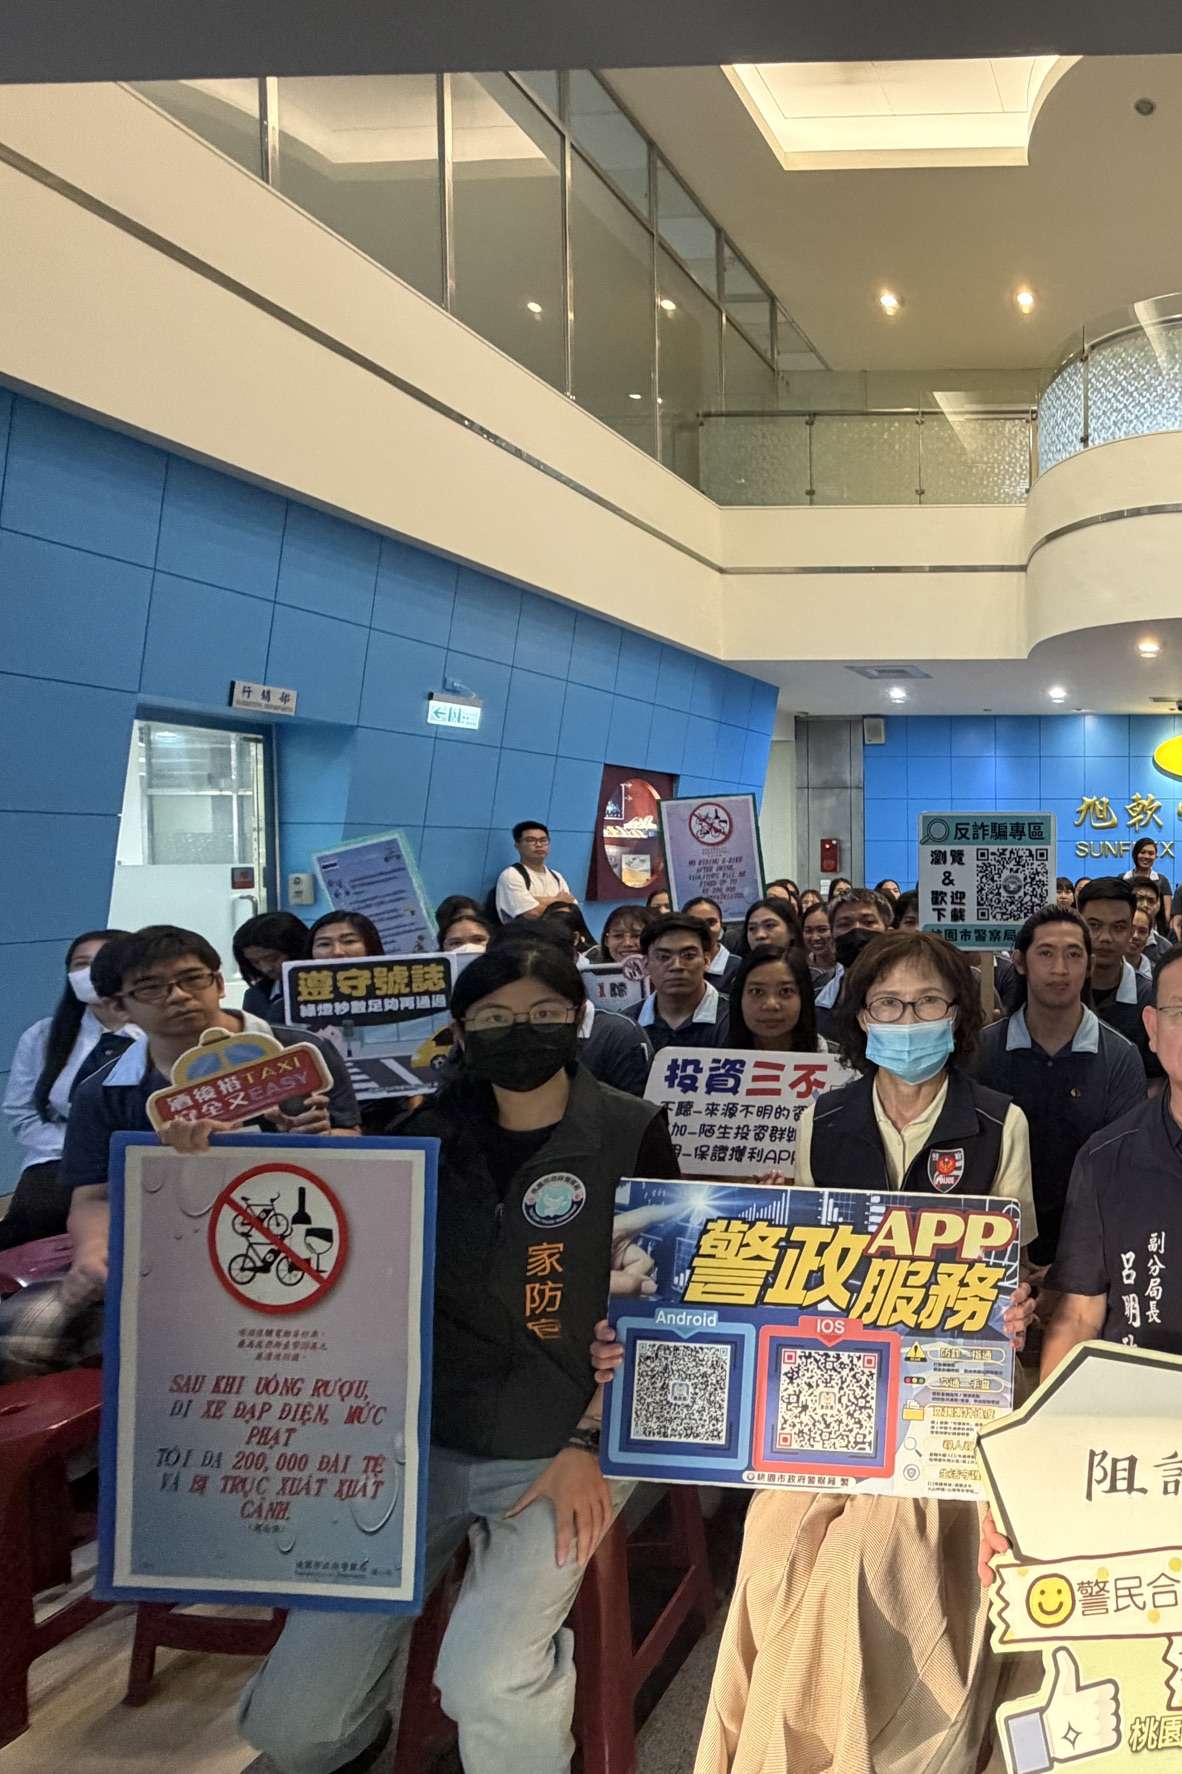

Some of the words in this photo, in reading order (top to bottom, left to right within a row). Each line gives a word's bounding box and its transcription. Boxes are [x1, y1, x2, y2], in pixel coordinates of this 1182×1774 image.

[954, 822, 1044, 840] 反詐騙專區
[930, 849, 965, 865] 瀏覽
[1075, 841, 1175, 857] SUNFX
[942, 871, 955, 886] &
[931, 890, 965, 906] 歡迎
[932, 907, 965, 922] 下載
[297, 963, 446, 1001] 遵守號誌
[664, 1058, 829, 1099] 投資三不
[867, 1209, 1015, 1260] APP
[1144, 1232, 1166, 1324] 副分局長
[655, 1311, 717, 1328] Android
[817, 1319, 845, 1334] IOS
